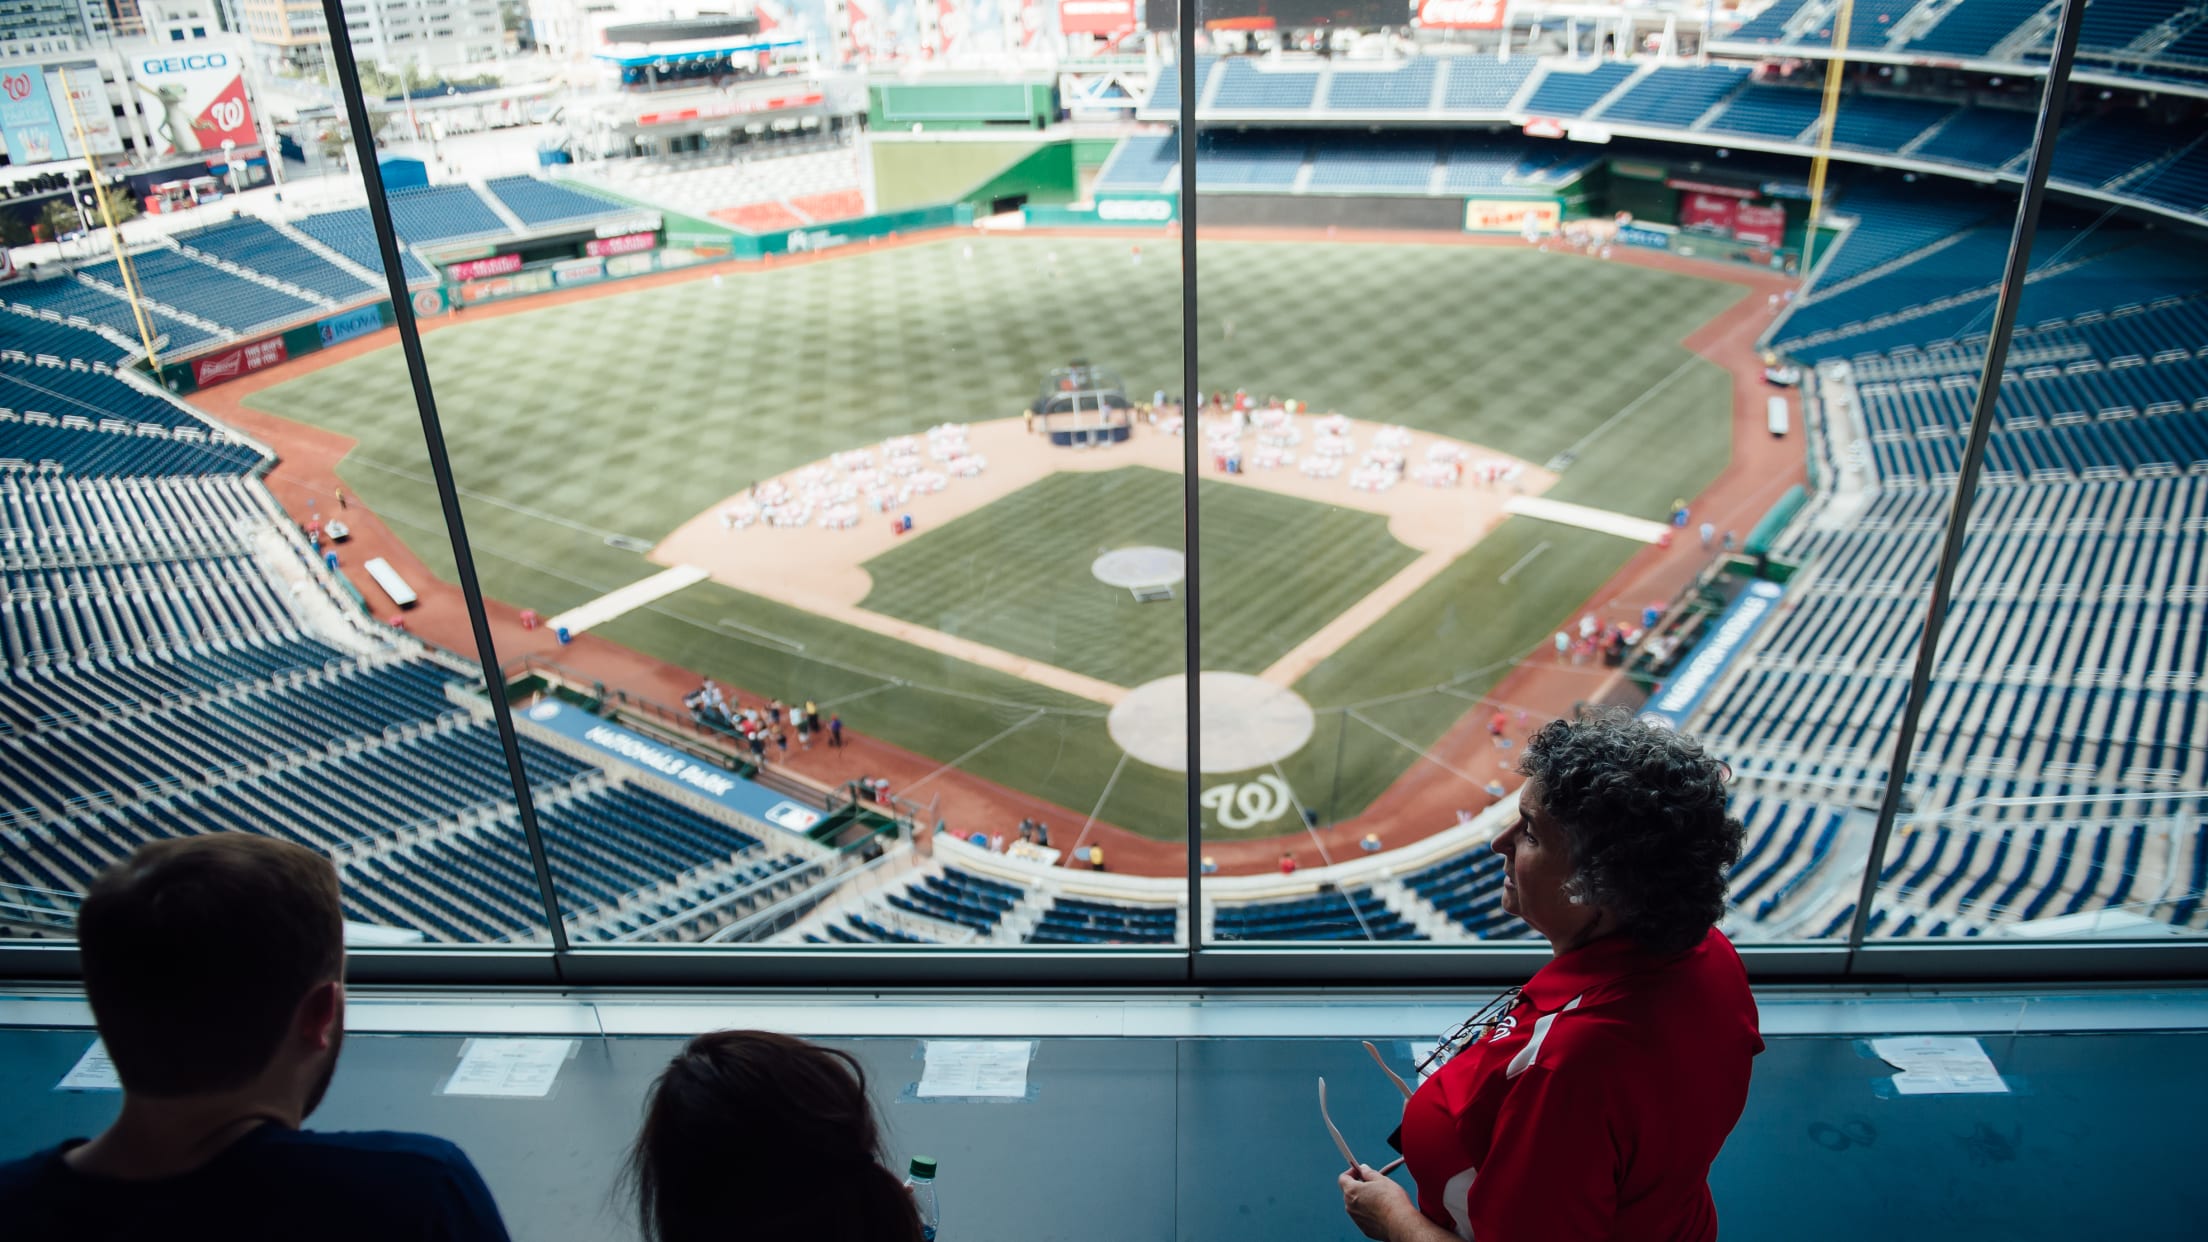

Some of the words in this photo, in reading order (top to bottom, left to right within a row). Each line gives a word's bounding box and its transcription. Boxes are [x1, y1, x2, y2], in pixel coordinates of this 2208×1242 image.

[143, 53, 228, 75] GEICO
[211, 97, 245, 131] W
[334, 313, 379, 337] INOVA
[1200, 773, 1291, 829] W
